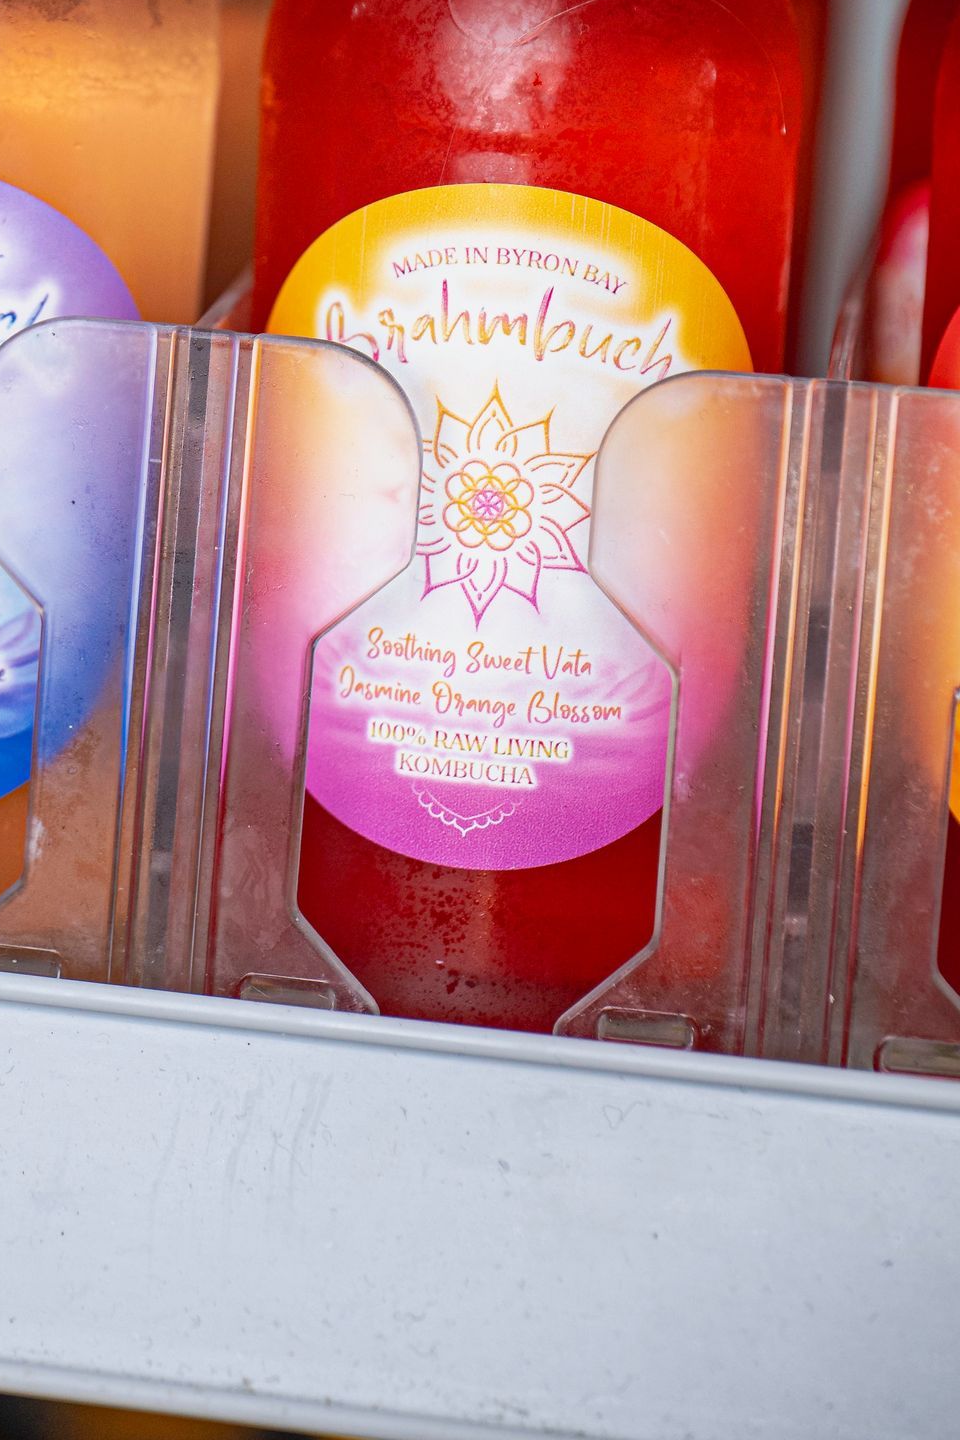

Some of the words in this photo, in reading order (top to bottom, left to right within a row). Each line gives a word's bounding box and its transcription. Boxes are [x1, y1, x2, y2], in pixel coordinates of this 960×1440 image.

[391, 247, 458, 279] MADE
[464, 245, 489, 265] IN
[495, 246, 579, 278] BYRON
[583, 262, 630, 297] BAY
[366, 626, 456, 678] Soothing
[465, 641, 538, 674] Sweet
[540, 644, 592, 680] Vata
[340, 664, 422, 707] Jasmine
[431, 680, 517, 729] Orange
[526, 690, 622, 725] Blossom
[368, 720, 428, 747] 100%
[432, 729, 488, 754] RAW
[492, 735, 570, 760] LIVING
[396, 752, 535, 787] KOMBUCHA
